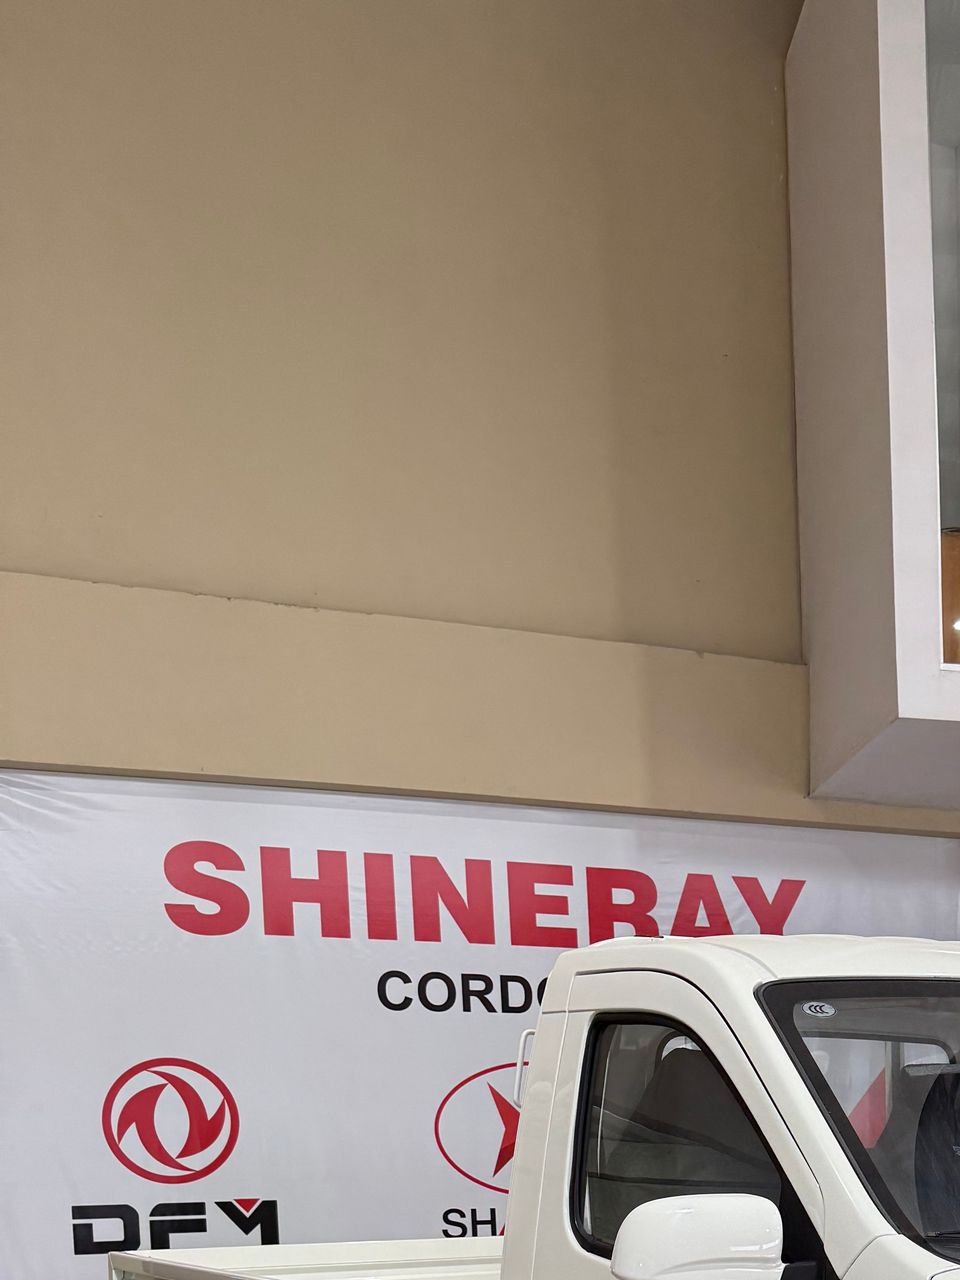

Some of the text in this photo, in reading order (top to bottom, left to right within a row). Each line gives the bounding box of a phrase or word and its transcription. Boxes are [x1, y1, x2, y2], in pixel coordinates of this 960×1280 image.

[163, 840, 807, 948] SHINERAY
[72, 1198, 280, 1255] DFM
[442, 1207, 506, 1238] SH
